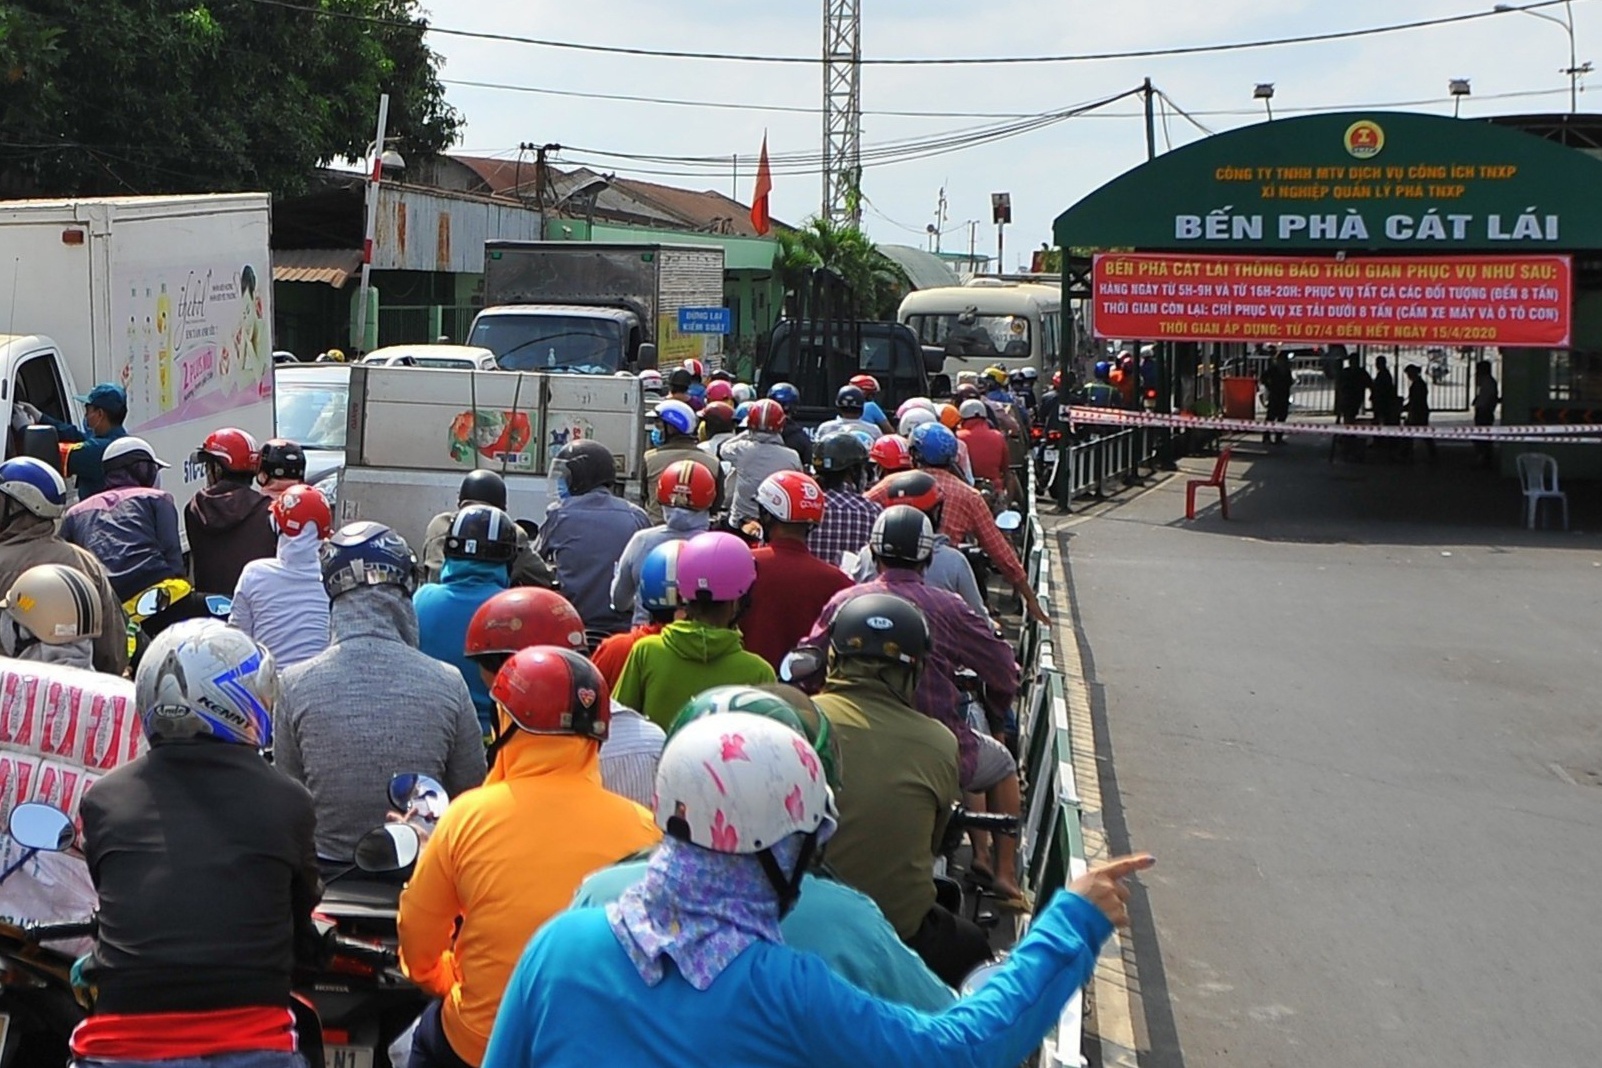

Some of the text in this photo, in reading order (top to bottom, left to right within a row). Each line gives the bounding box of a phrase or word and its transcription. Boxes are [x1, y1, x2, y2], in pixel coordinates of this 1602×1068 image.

[1215, 165, 1253, 180] CÔNG
[1258, 167, 1272, 180] TY
[1276, 167, 1312, 180] TNHH
[1316, 167, 1345, 180] MTV
[1386, 165, 1403, 182] VỤ
[1408, 163, 1446, 179] CÔNG
[1479, 165, 1517, 179] TNXP
[1279, 183, 1330, 201] NGHIỆP
[1376, 181, 1391, 198] LÝ
[1429, 184, 1466, 198] TNXP
[1175, 205, 1558, 240] BẾN PHÀ CÁT LÁI
[1105, 258, 1557, 282] BẾN PHÀ CÁT LÁI THÔNG BÁO THỜI GIAN PHỤC VỤ NHƯ SAU:
[1099, 281, 1128, 295] HÀNG
[1178, 284, 1212, 296] 5H-9H
[1250, 285, 1302, 297] 16H-20H:
[1304, 286, 1335, 300] PHỤC
[1338, 286, 1354, 300] VỤ
[1357, 282, 1377, 298] TẤT
[1398, 284, 1422, 298] CÁC
[1520, 287, 1529, 299] 8
[1531, 284, 1558, 302] TẤN)
[1132, 302, 1157, 314] GIAN
[1187, 303, 1208, 317] LẠI:
[1235, 304, 1267, 318] PHỤC
[1270, 304, 1285, 318] VỤ
[1289, 305, 1302, 316] XE
[1359, 306, 1367, 317] 8
[1370, 302, 1393, 318] TẤN
[1431, 307, 1446, 318] XE
[1449, 304, 1475, 318] MÁY
[1191, 322, 1220, 334] GIAN
[1243, 323, 1282, 337] DỤNG:
[1305, 324, 1332, 336] 07/4
[1366, 321, 1390, 337] HẾT
[1394, 323, 1428, 338] NGÀY
[1432, 326, 1497, 339] 15/4/2020
[315, 984, 349, 993] HONDA
